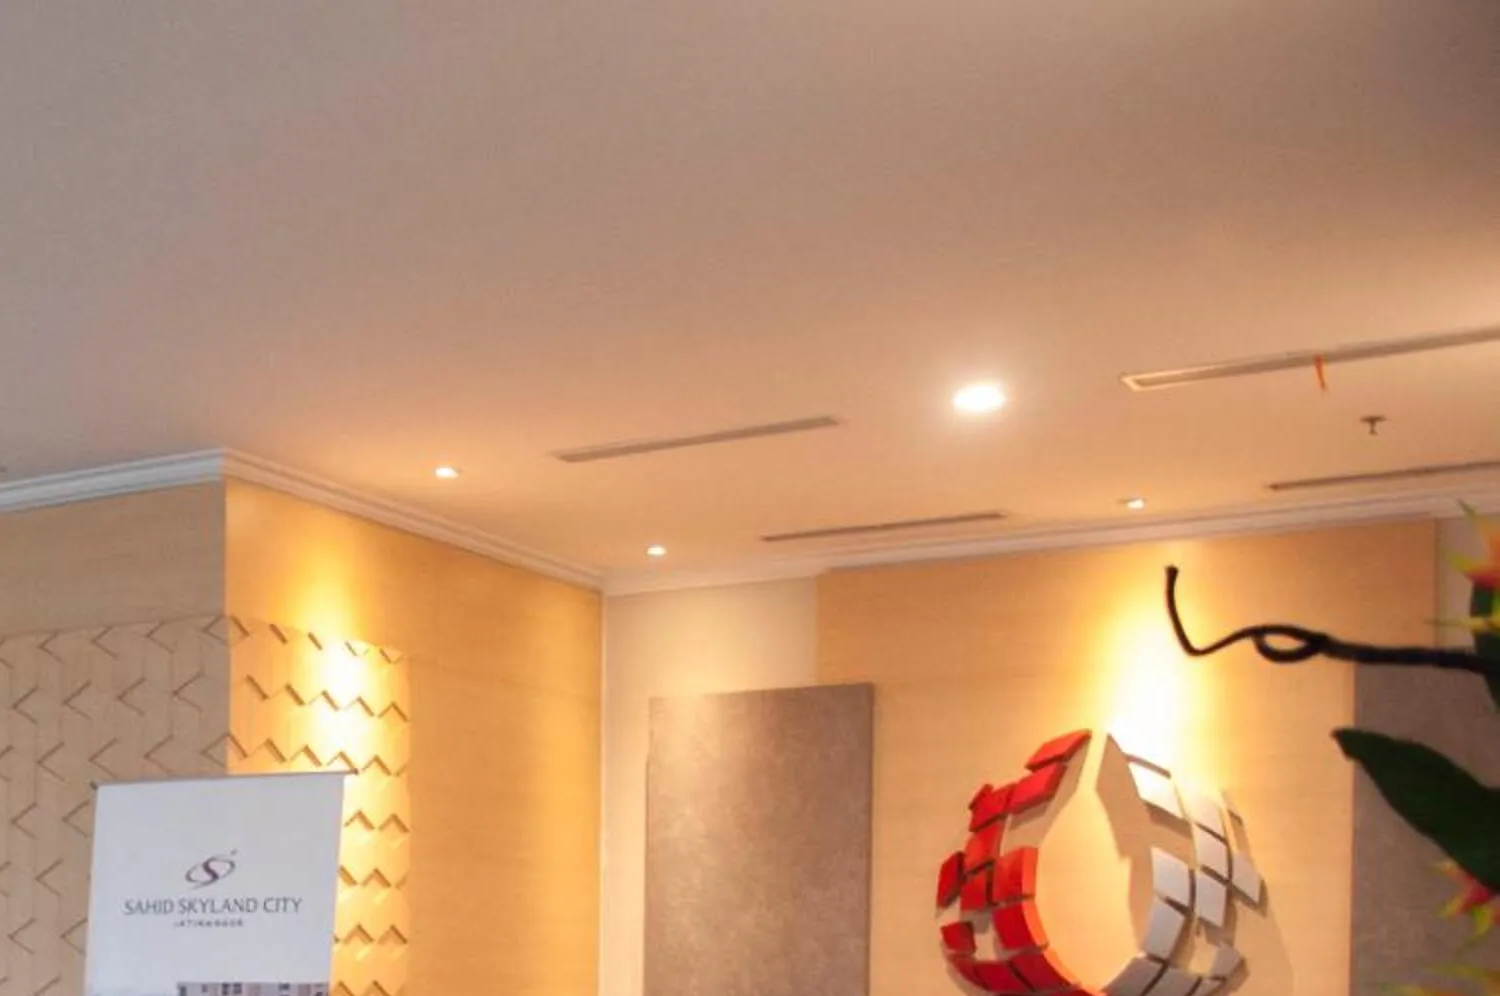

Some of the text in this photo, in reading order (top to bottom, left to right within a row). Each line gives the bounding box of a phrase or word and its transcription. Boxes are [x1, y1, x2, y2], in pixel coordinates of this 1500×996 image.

[123, 897, 303, 916] SAHID SKYLAND CITY
